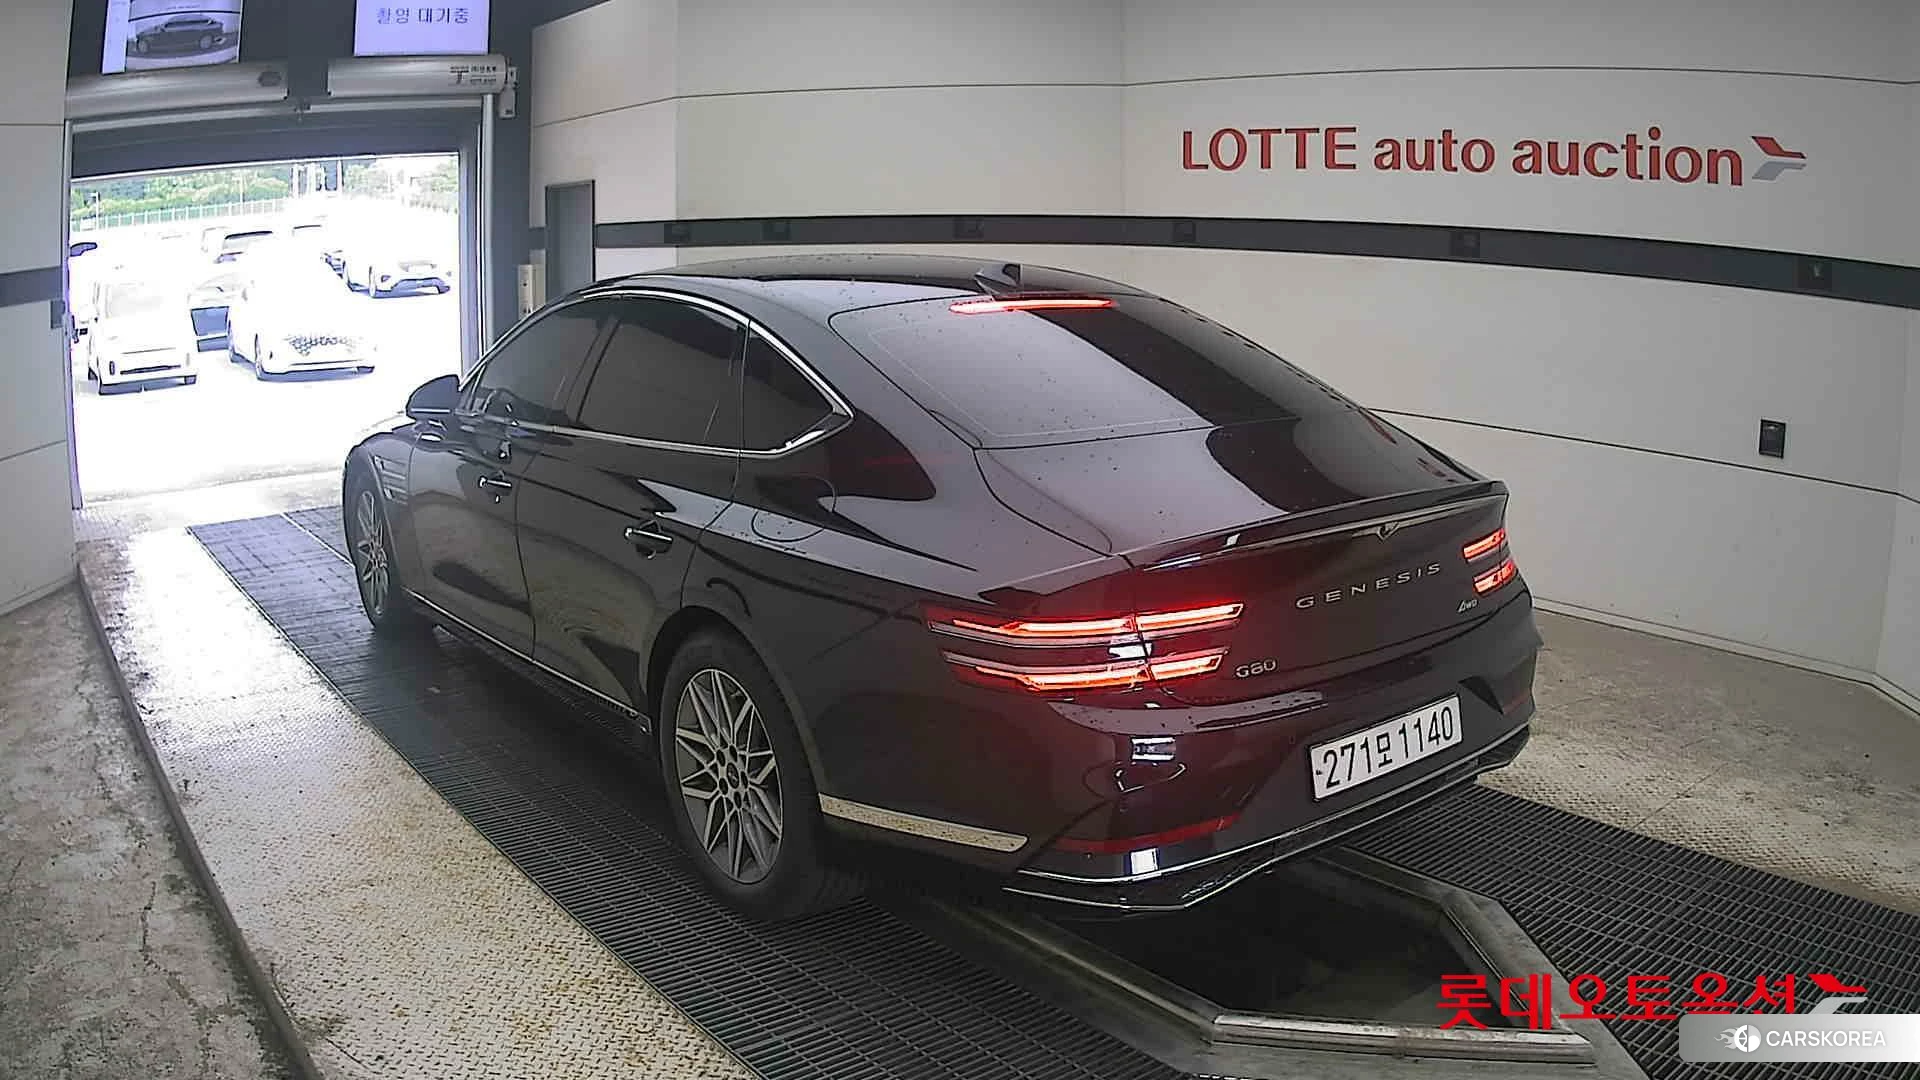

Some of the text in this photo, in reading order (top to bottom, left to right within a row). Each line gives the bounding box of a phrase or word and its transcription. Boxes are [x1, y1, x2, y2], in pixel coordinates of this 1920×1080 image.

[418, 8, 470, 24] 대기중
[1182, 126, 1744, 187] LOTTE auto auction
[1296, 562, 1442, 610] GENESIS
[1235, 659, 1278, 679] G80
